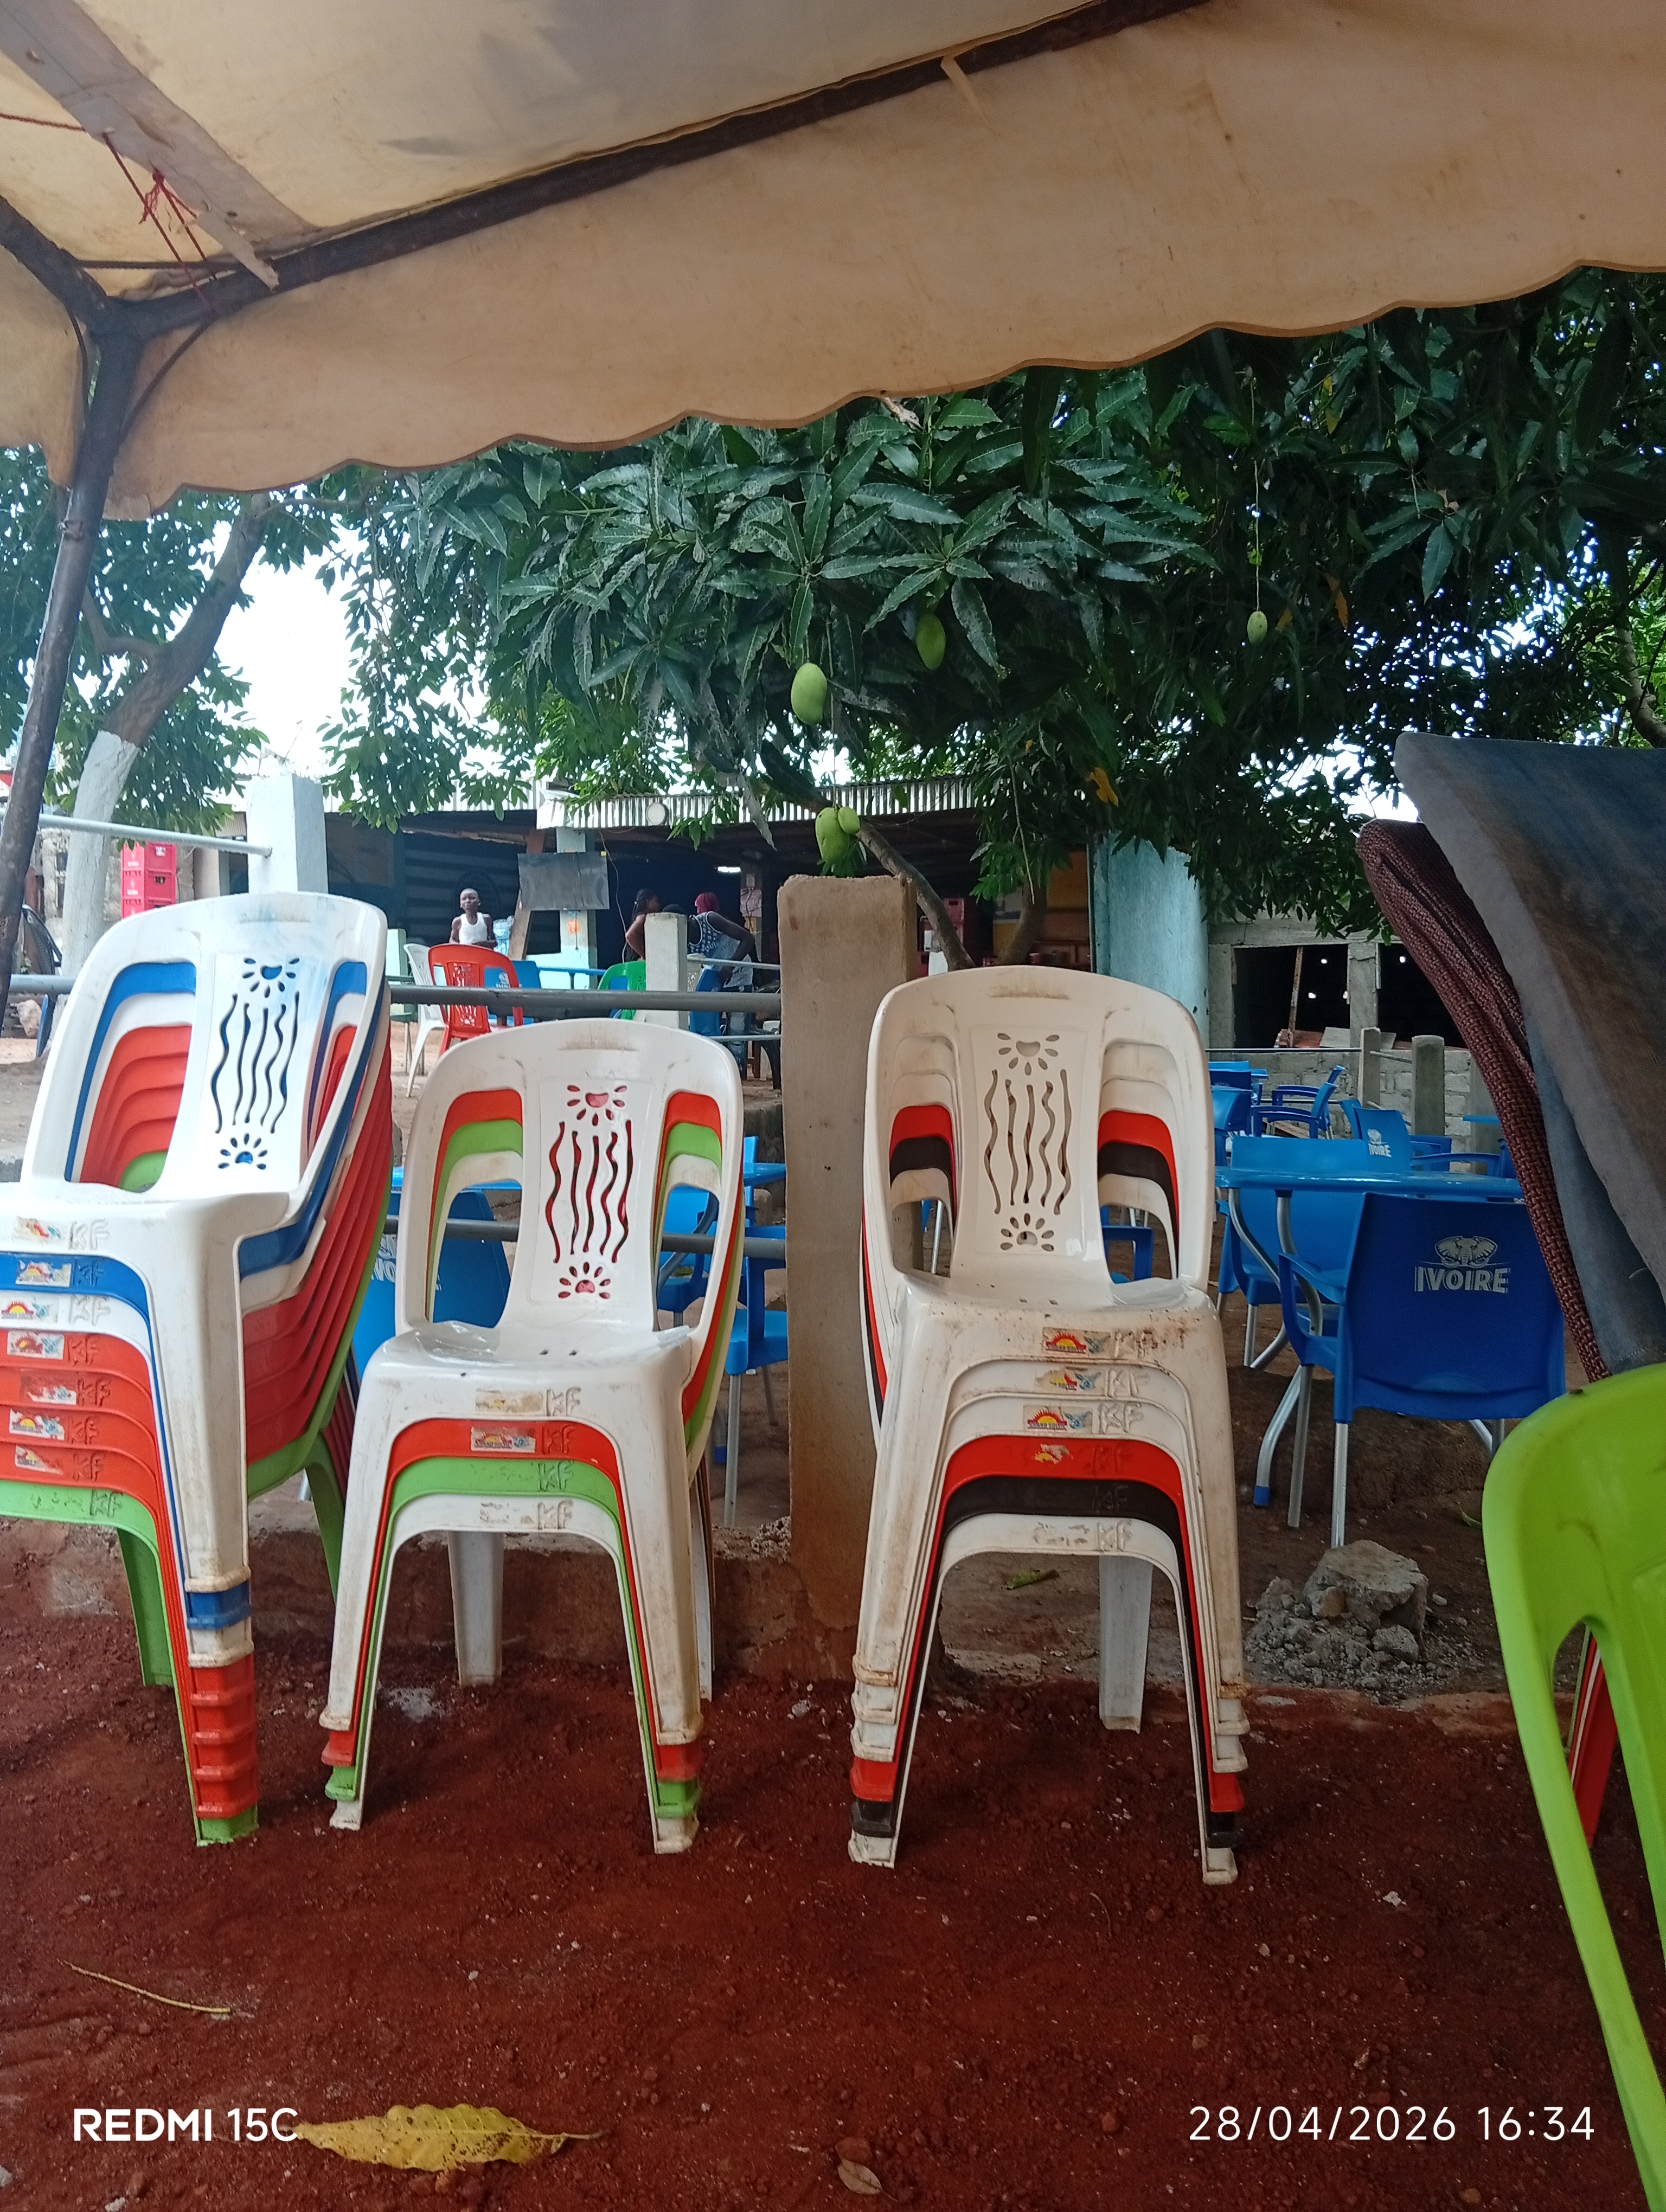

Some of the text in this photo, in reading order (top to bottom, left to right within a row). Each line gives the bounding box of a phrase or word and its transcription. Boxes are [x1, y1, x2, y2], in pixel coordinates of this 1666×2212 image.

[1368, 1143, 1392, 1158] IVOIRE
[69, 1218, 110, 1251] KF
[1414, 1266, 1510, 1293] IVOIRE
[68, 1294, 111, 1326] KF
[67, 1333, 100, 1365] KF
[78, 1378, 111, 1407] KF
[546, 1387, 581, 1416] KF
[67, 1417, 100, 1444] KF
[542, 1424, 578, 1455] KF
[73, 1451, 103, 1481] KF
[538, 1459, 574, 1491] KF
[89, 1490, 123, 1516] KF
[538, 1500, 574, 1529] KF
[1097, 1519, 1132, 1551] KF
